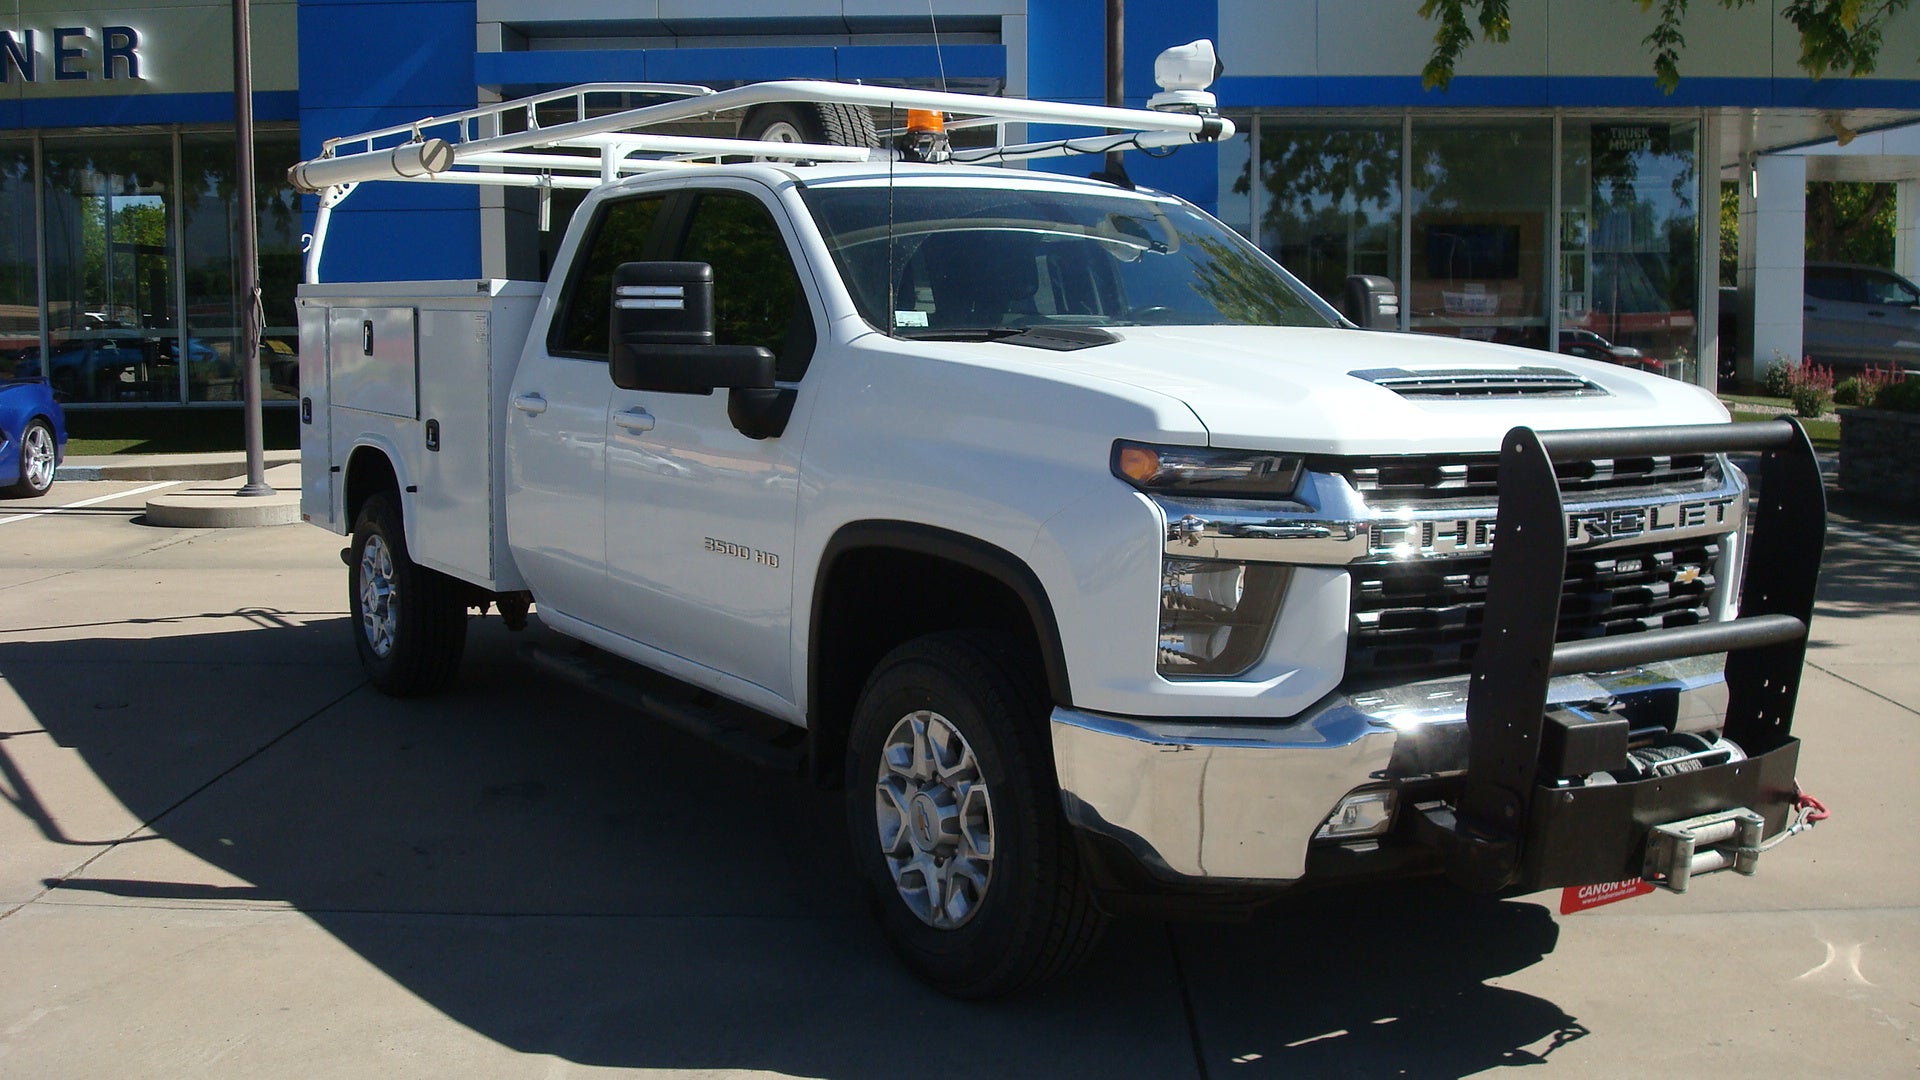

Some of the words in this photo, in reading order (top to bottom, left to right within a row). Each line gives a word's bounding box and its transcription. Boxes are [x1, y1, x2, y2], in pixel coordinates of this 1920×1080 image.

[1610, 127, 1650, 139] TRUCK
[1608, 138, 1652, 151] MONTH
[1369, 499, 1735, 556] CHEROLET
[704, 536, 750, 560] 3500
[754, 549, 780, 569] HD
[1578, 881, 1619, 899] CANON
